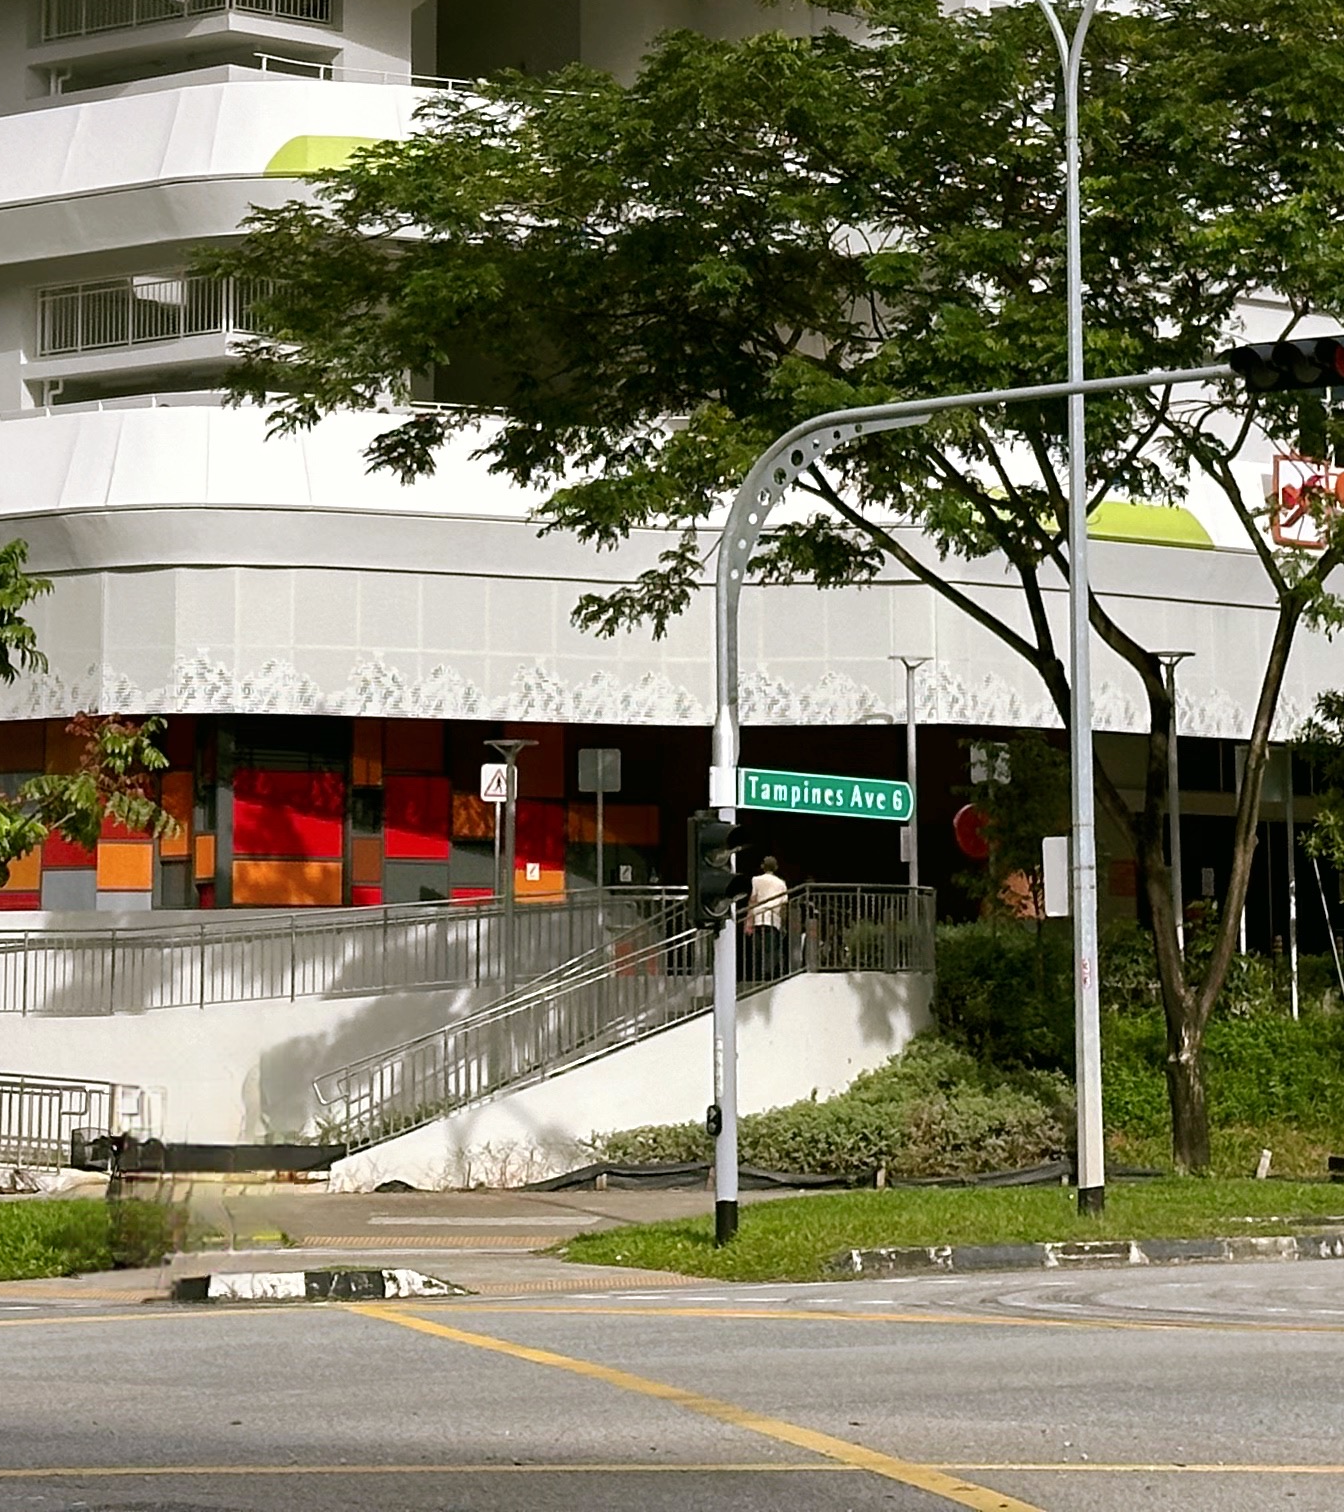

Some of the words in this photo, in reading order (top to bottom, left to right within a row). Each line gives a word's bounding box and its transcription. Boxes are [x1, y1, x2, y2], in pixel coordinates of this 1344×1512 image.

[748, 775, 844, 808] Tampines
[850, 784, 886, 810] Ave
[892, 789, 903, 811] 6
